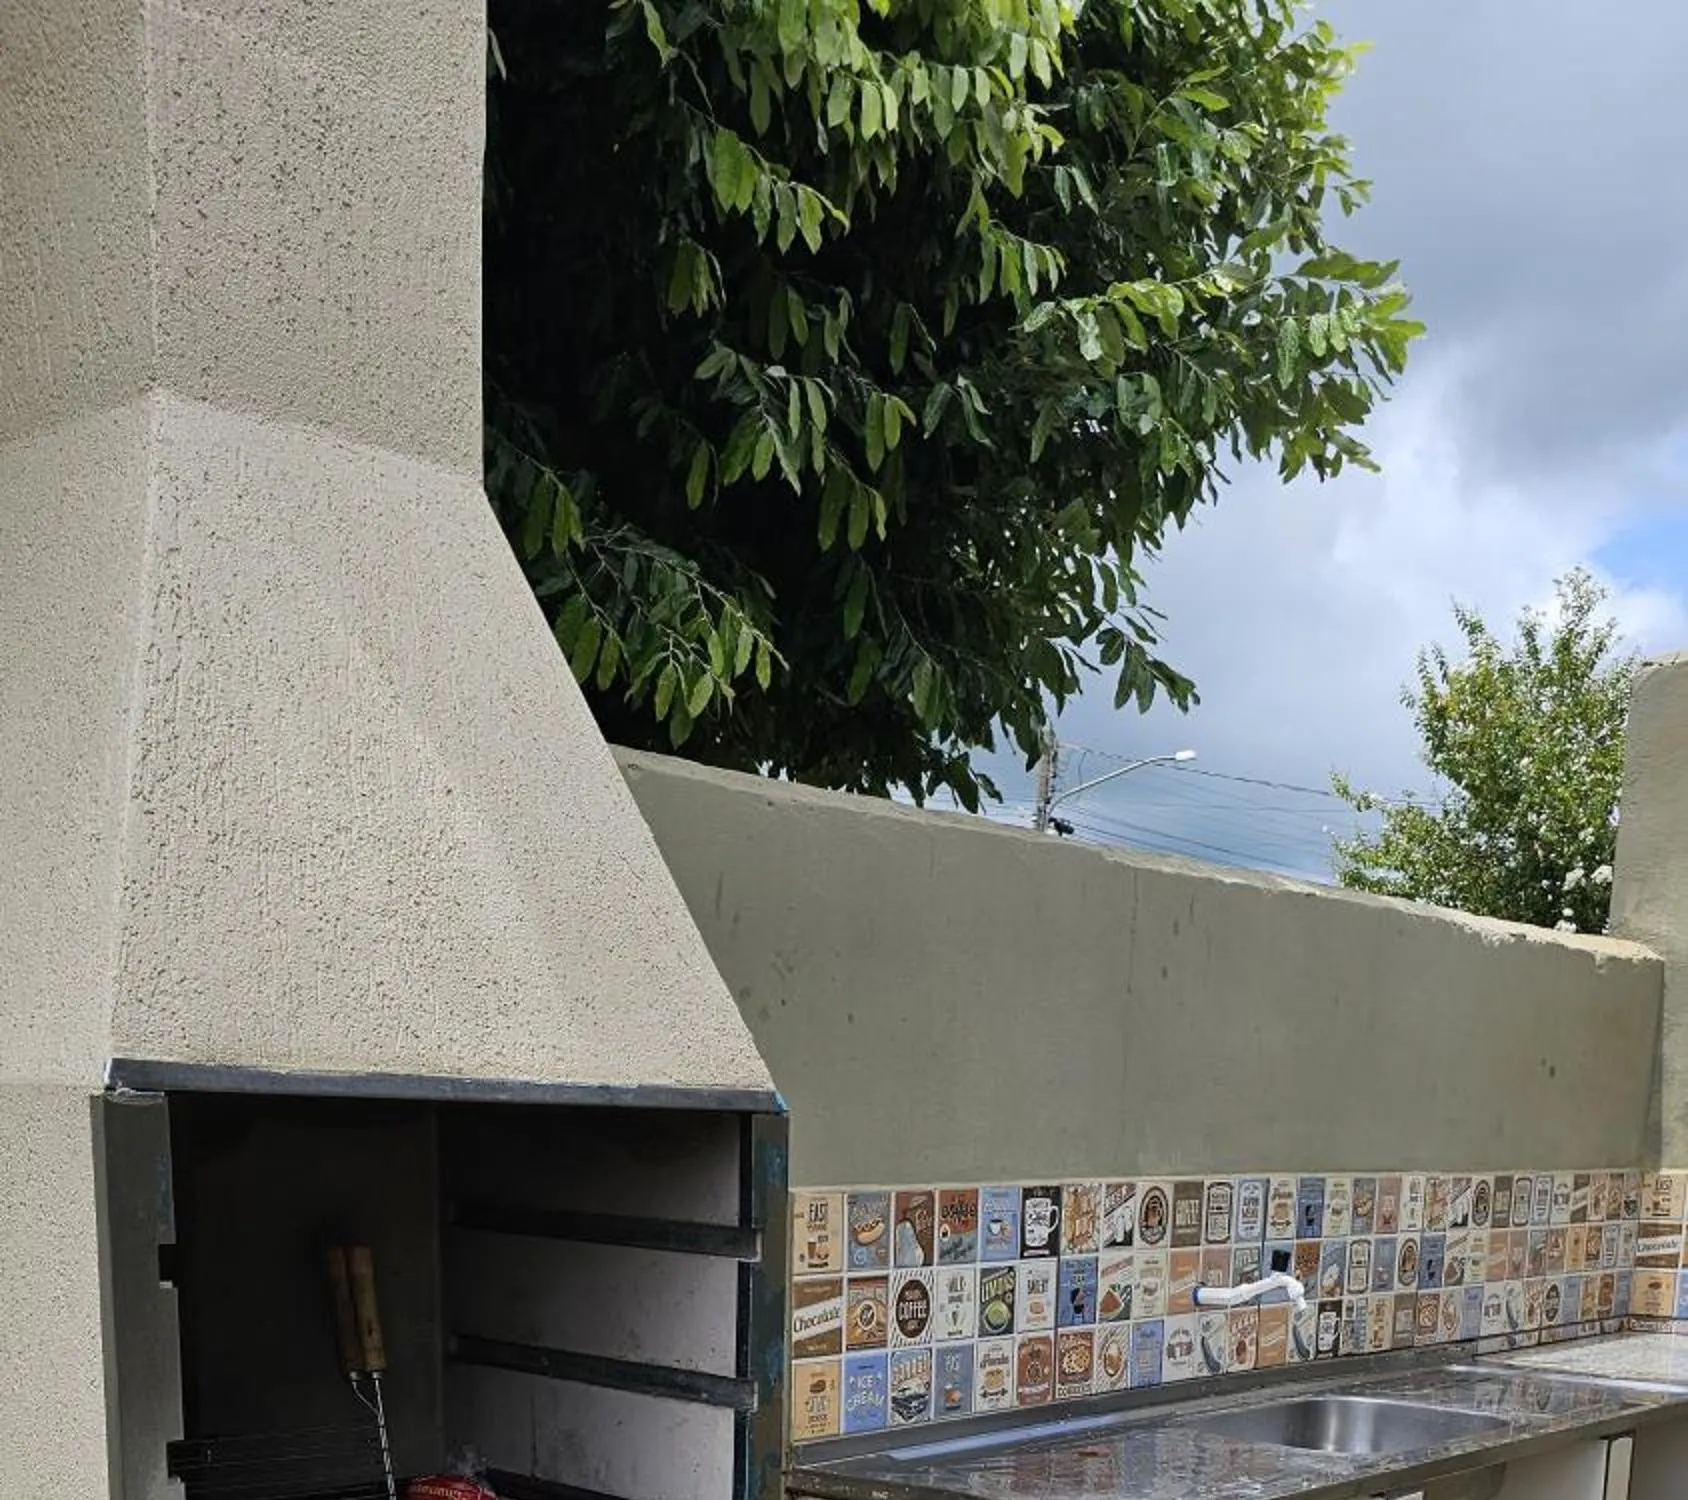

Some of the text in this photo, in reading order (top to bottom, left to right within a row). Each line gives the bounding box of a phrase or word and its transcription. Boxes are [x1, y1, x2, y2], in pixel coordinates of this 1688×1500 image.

[794, 1306, 841, 1333] Chocolate
[899, 1301, 927, 1320] COFFEE
[847, 1390, 885, 1411] CREAM
